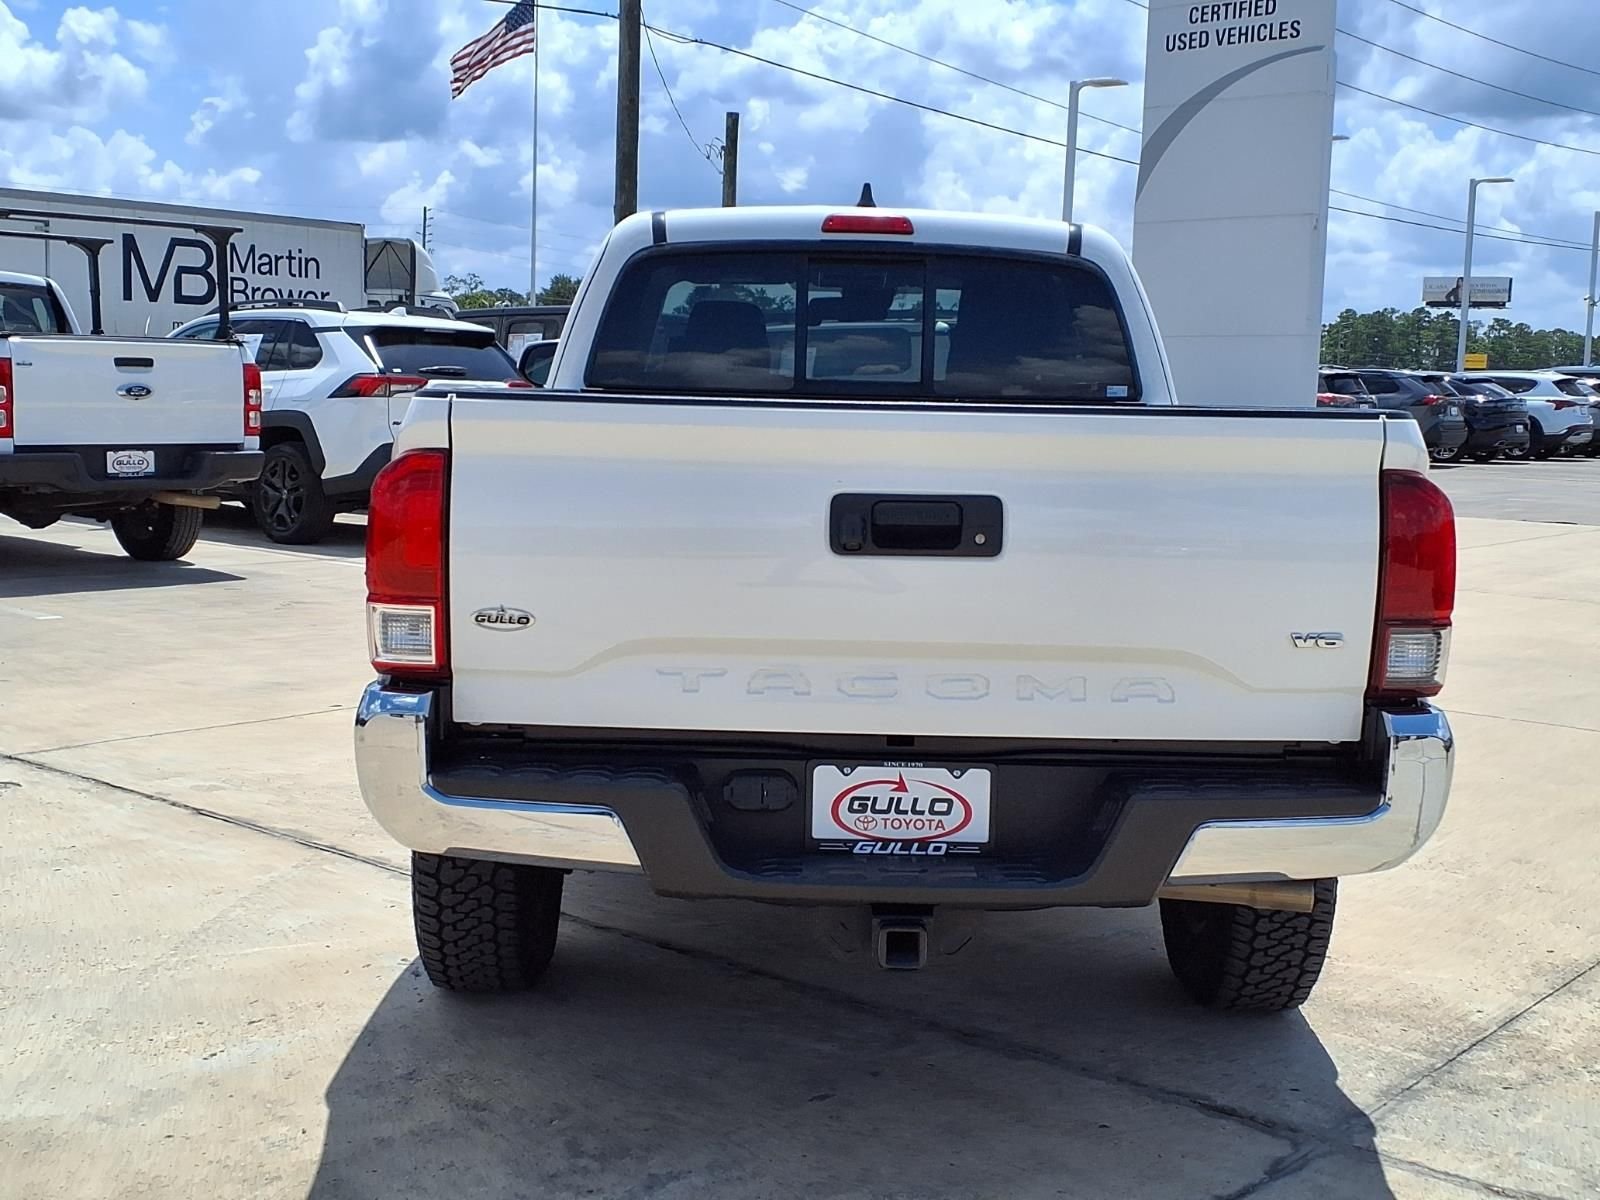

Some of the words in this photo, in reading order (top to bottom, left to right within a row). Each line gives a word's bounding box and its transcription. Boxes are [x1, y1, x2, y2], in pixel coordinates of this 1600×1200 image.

[1189, 0, 1277, 25] CERTIFIED
[1165, 30, 1210, 53] USED
[1215, 20, 1301, 46] VEHICLES
[229, 241, 321, 280] Martin
[474, 614, 531, 625] GULLO
[1290, 631, 1345, 649] V6
[655, 666, 1177, 703] TACOMA
[847, 796, 955, 816] GULLO
[881, 818, 946, 831] TOYOTA
[852, 842, 948, 855] GULLO
